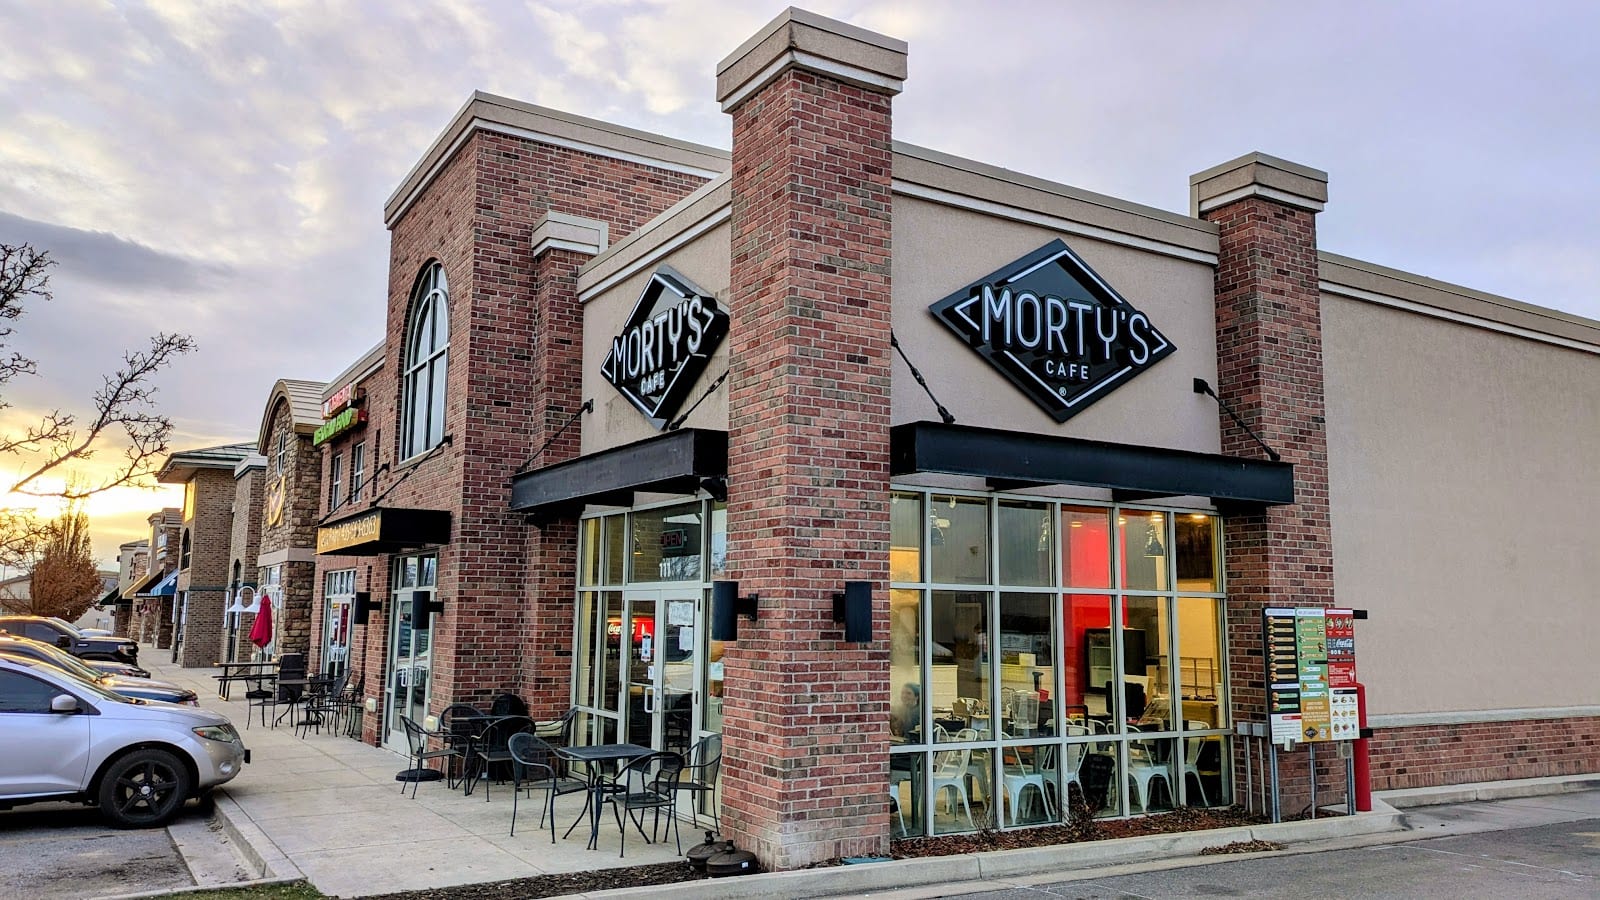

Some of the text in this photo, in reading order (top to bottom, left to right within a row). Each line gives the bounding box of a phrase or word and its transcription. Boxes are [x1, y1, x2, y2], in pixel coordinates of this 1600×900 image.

[613, 295, 703, 384] MORTY'S
[984, 286, 1149, 365] MORTY'S
[640, 369, 665, 396] CAFE
[1045, 360, 1089, 380] CAFE
